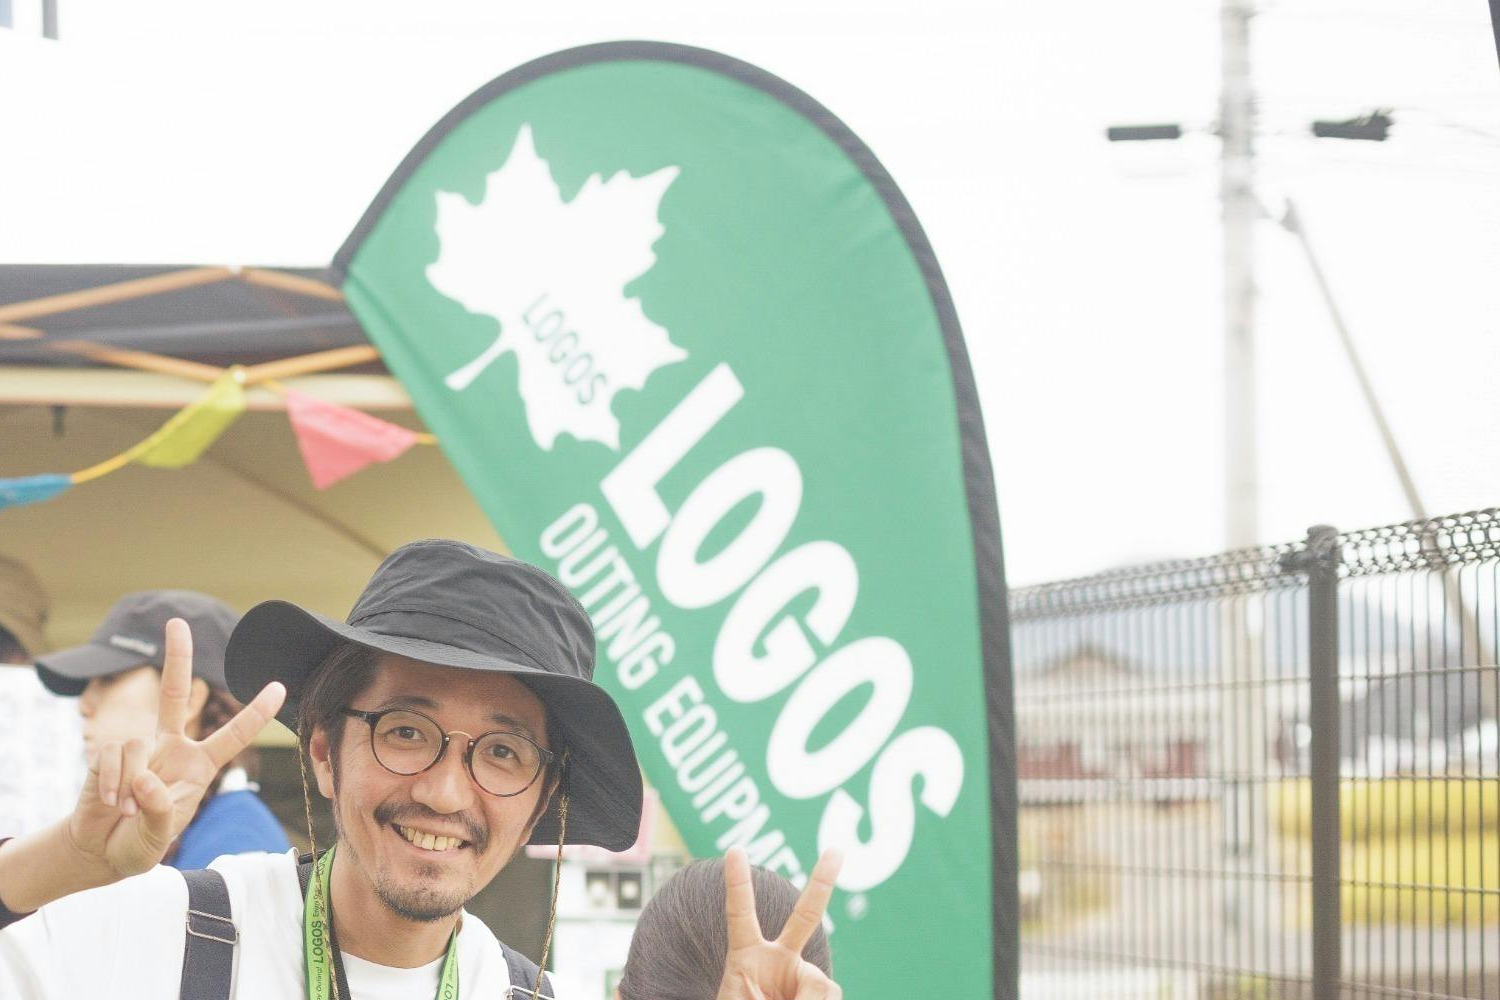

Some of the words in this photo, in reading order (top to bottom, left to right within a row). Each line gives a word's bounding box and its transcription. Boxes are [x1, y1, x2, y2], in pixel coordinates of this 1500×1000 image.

[521, 291, 610, 405] LOGOS
[540, 502, 676, 691] OUTING
[642, 677, 835, 937] EQUIPM
[601, 362, 965, 893] LOGOS
[311, 920, 324, 964] LOGOS
